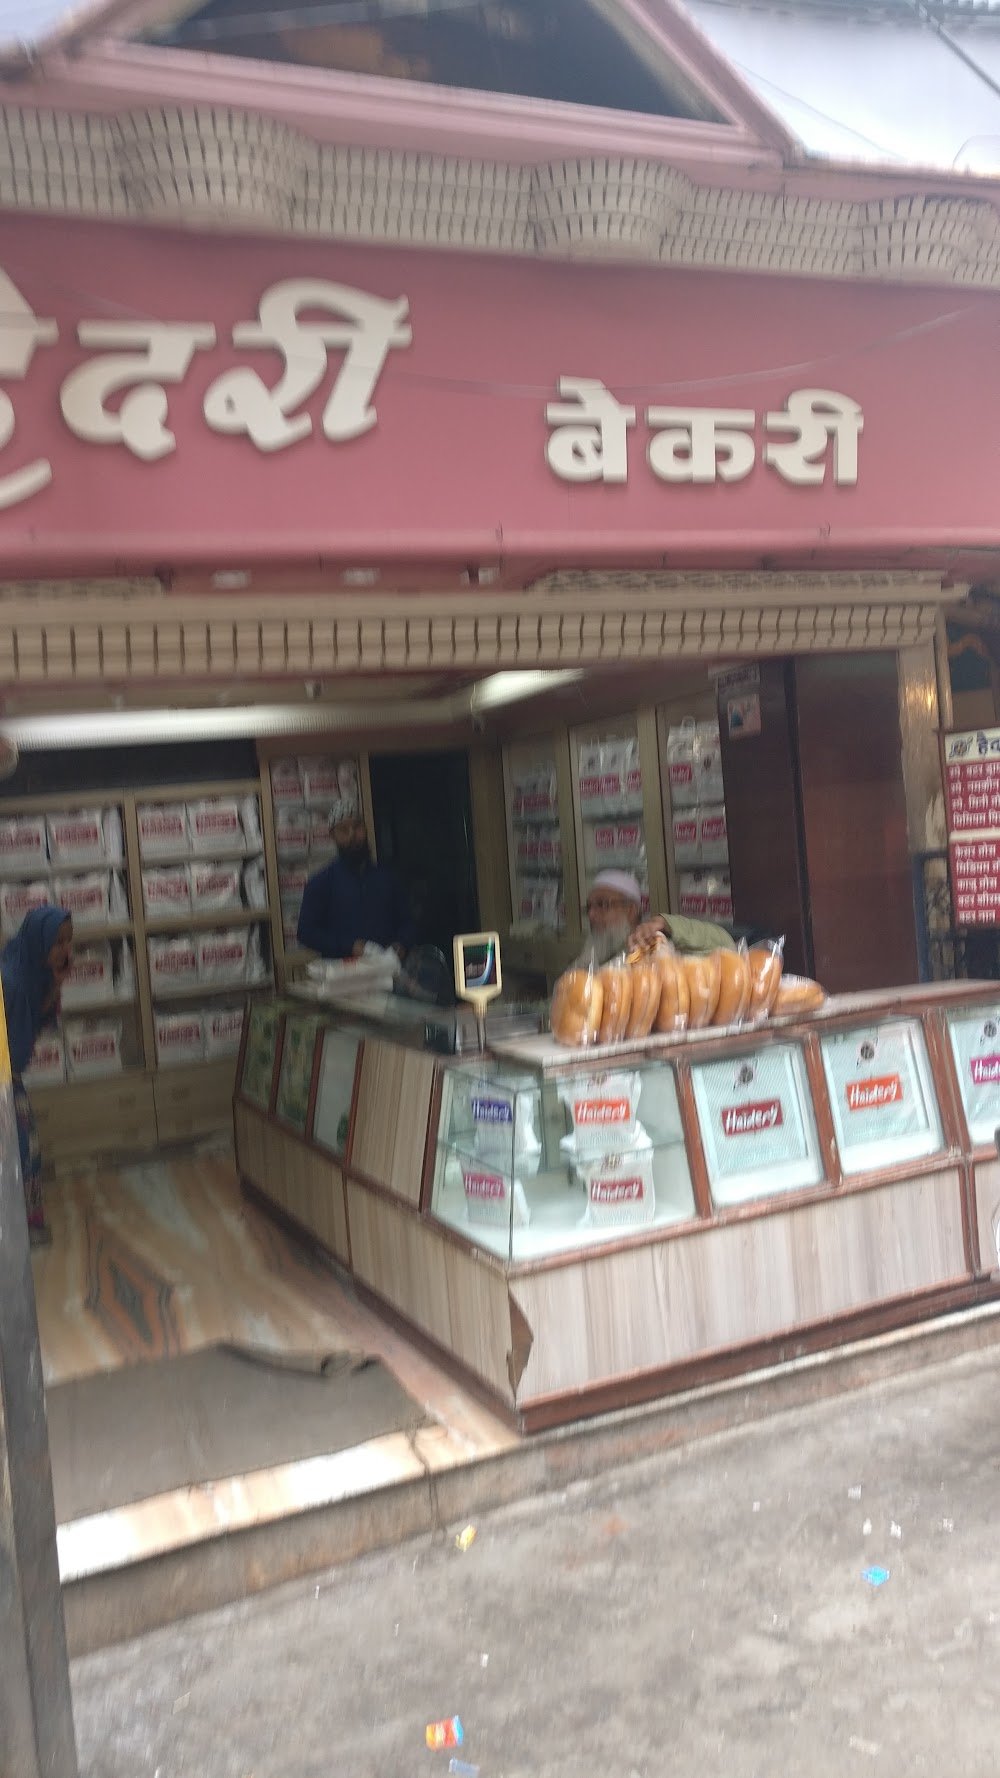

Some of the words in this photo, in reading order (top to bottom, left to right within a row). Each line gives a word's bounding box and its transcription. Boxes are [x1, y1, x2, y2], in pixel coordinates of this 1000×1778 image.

[545, 375, 864, 485] बेकरी
[850, 1080, 898, 1107] Haidery
[577, 1101, 628, 1123] Haidery
[726, 1104, 779, 1136] Haidery
